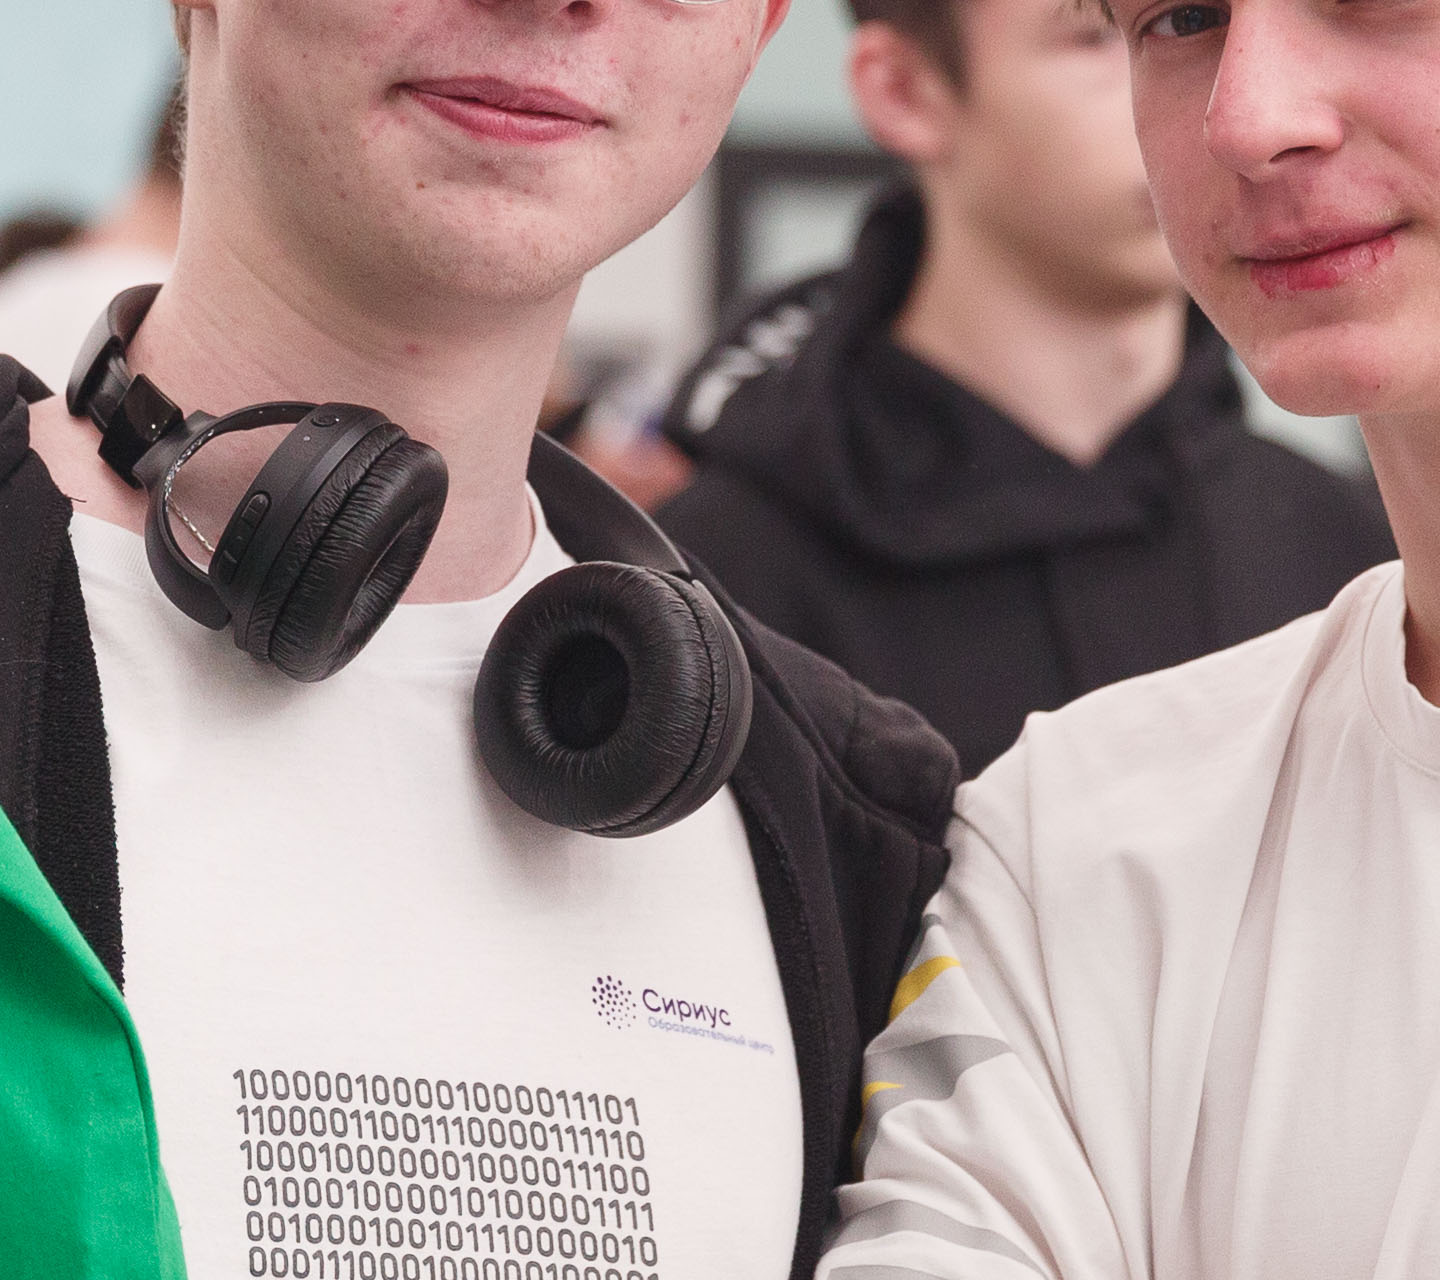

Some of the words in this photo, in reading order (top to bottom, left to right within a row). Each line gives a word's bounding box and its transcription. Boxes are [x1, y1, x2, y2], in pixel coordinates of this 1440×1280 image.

[642, 989, 731, 1028] Сириус
[233, 1069, 639, 1126] 100000100001000011101
[236, 1105, 644, 1161] 11000011001110000111110
[240, 1140, 650, 1196] 100010000001000011100
[244, 1176, 654, 1231] 010001000010100001111
[246, 1211, 658, 1266] 001000100101110000010
